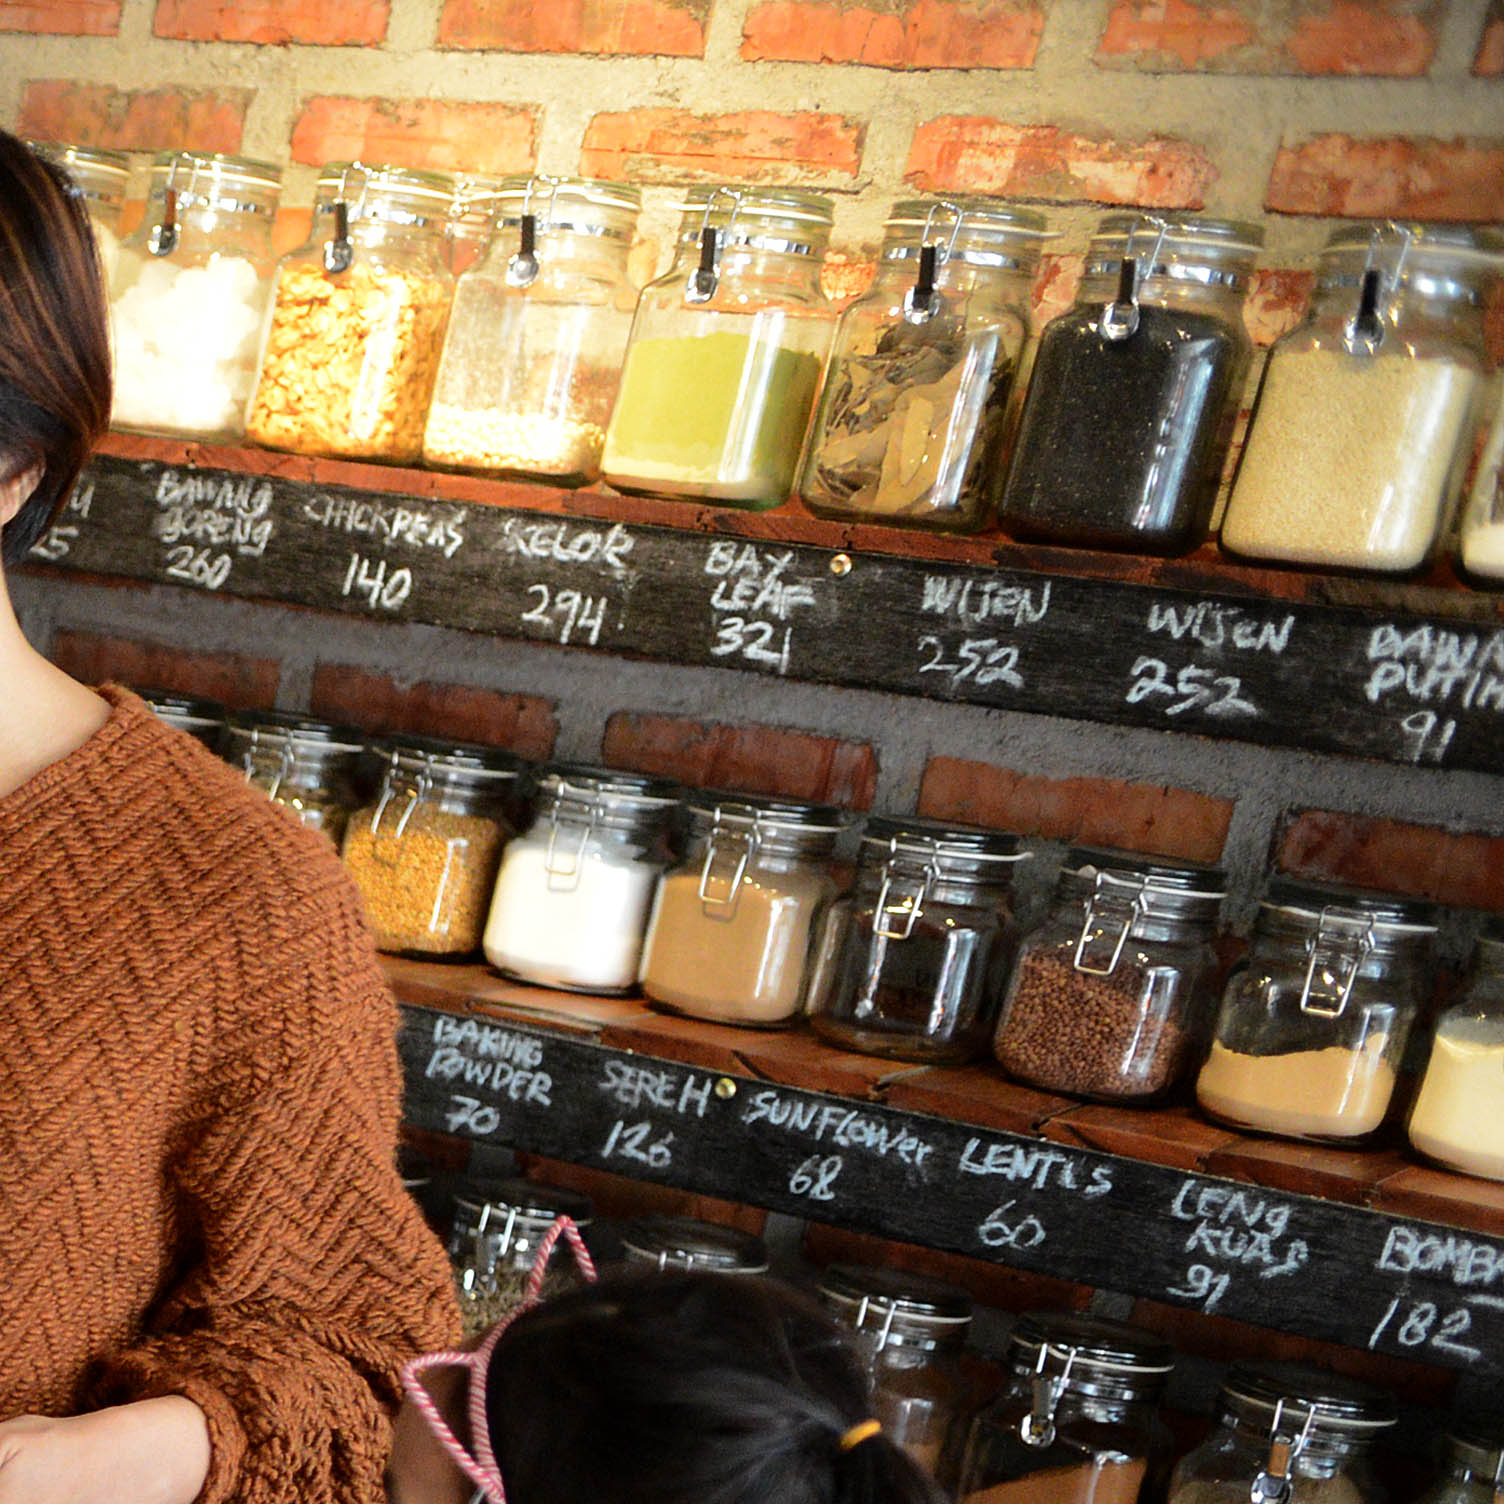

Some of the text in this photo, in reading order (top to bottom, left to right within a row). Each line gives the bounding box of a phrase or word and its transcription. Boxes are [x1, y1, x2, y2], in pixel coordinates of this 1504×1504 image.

[302, 495, 468, 560] CHICKPEAS
[167, 545, 232, 590] 260
[341, 552, 412, 610] 140
[703, 540, 795, 582] BAY
[521, 583, 608, 646] 294
[710, 576, 816, 621] LEAF
[710, 616, 793, 675] 321
[917, 635, 1026, 691] 252
[1125, 655, 1260, 716] 252
[1400, 711, 1457, 763] 91
[432, 1016, 543, 1069] BAKING
[425, 1048, 553, 1107] POWDER
[597, 1059, 713, 1118] SEREH
[445, 1095, 501, 1135] 70
[602, 1120, 673, 1169] 126
[789, 1154, 844, 1201] 68
[978, 1199, 1047, 1251] 60
[1368, 1298, 1481, 1361] 182
